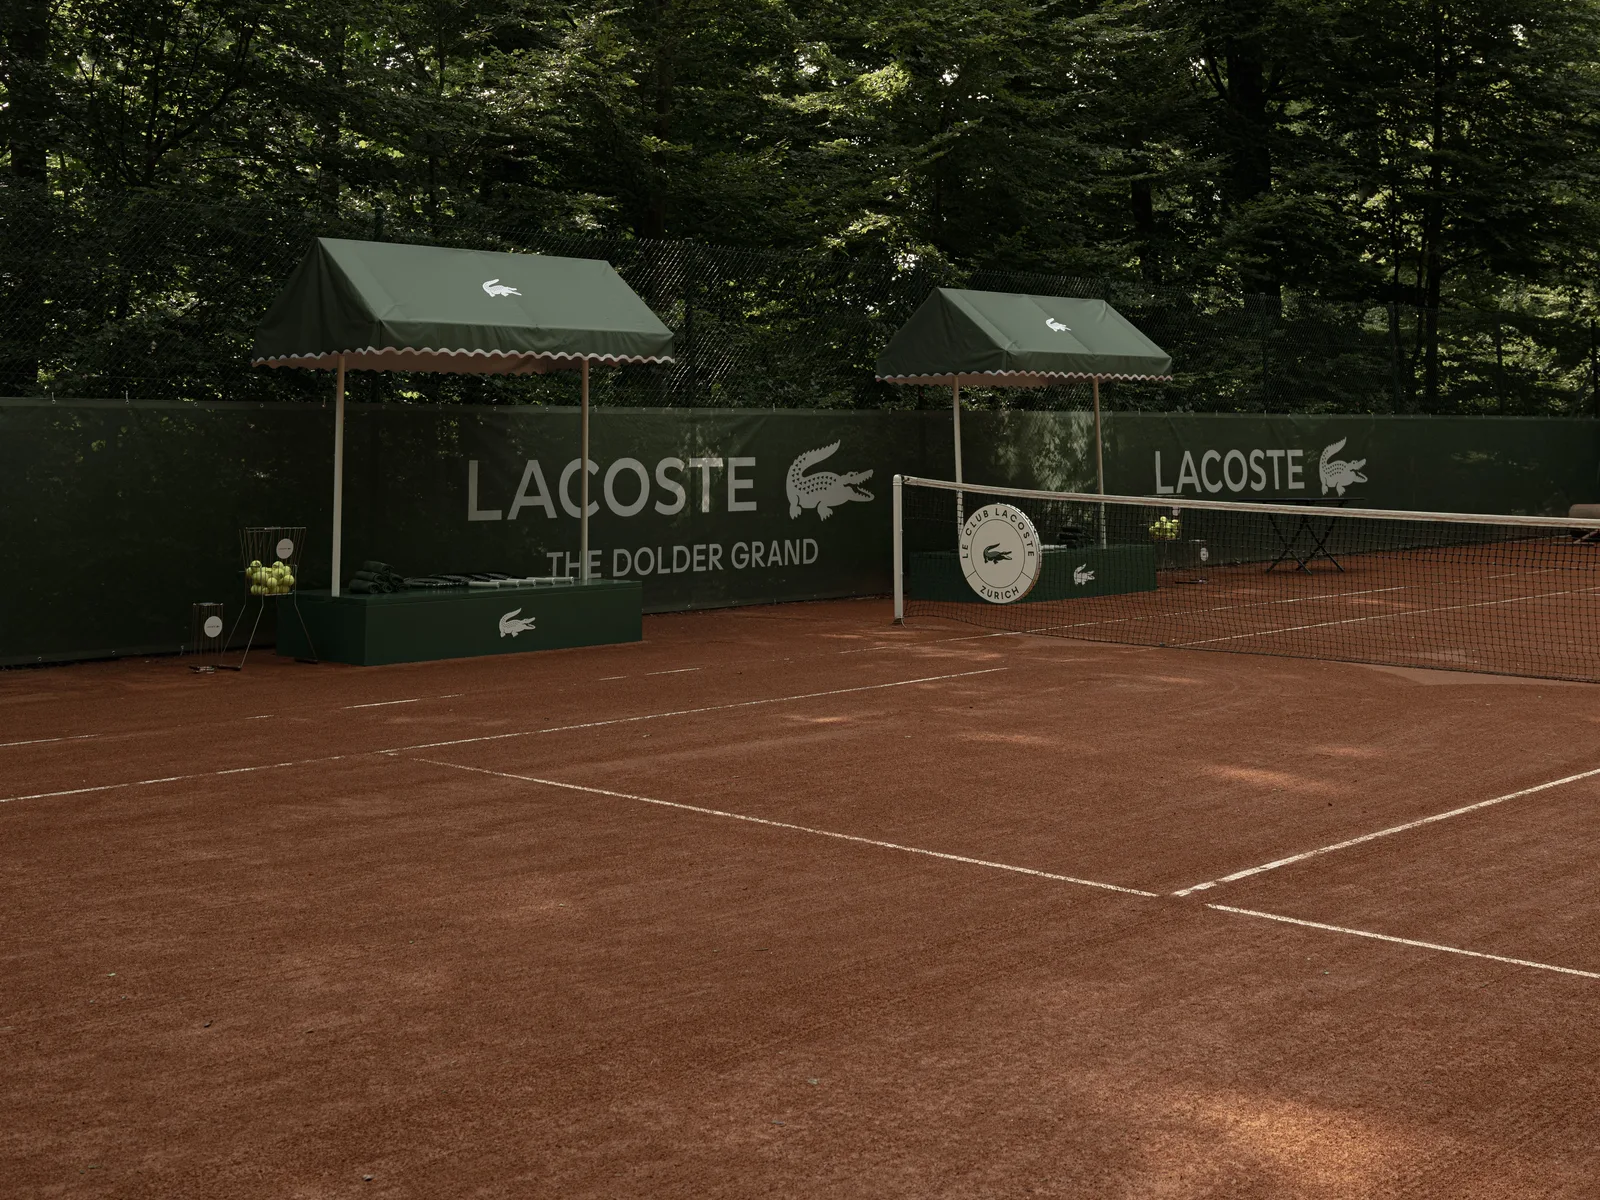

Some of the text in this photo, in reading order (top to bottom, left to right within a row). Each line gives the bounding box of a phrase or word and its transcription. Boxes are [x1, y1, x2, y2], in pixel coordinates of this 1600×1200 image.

[468, 456, 757, 521] LACOSTE
[1155, 449, 1305, 494] LACOSTE
[962, 508, 1034, 559] LE CLUB LACOSTE
[546, 538, 819, 579] THE DOLDER GRAND
[980, 585, 1019, 600] ZURICH
